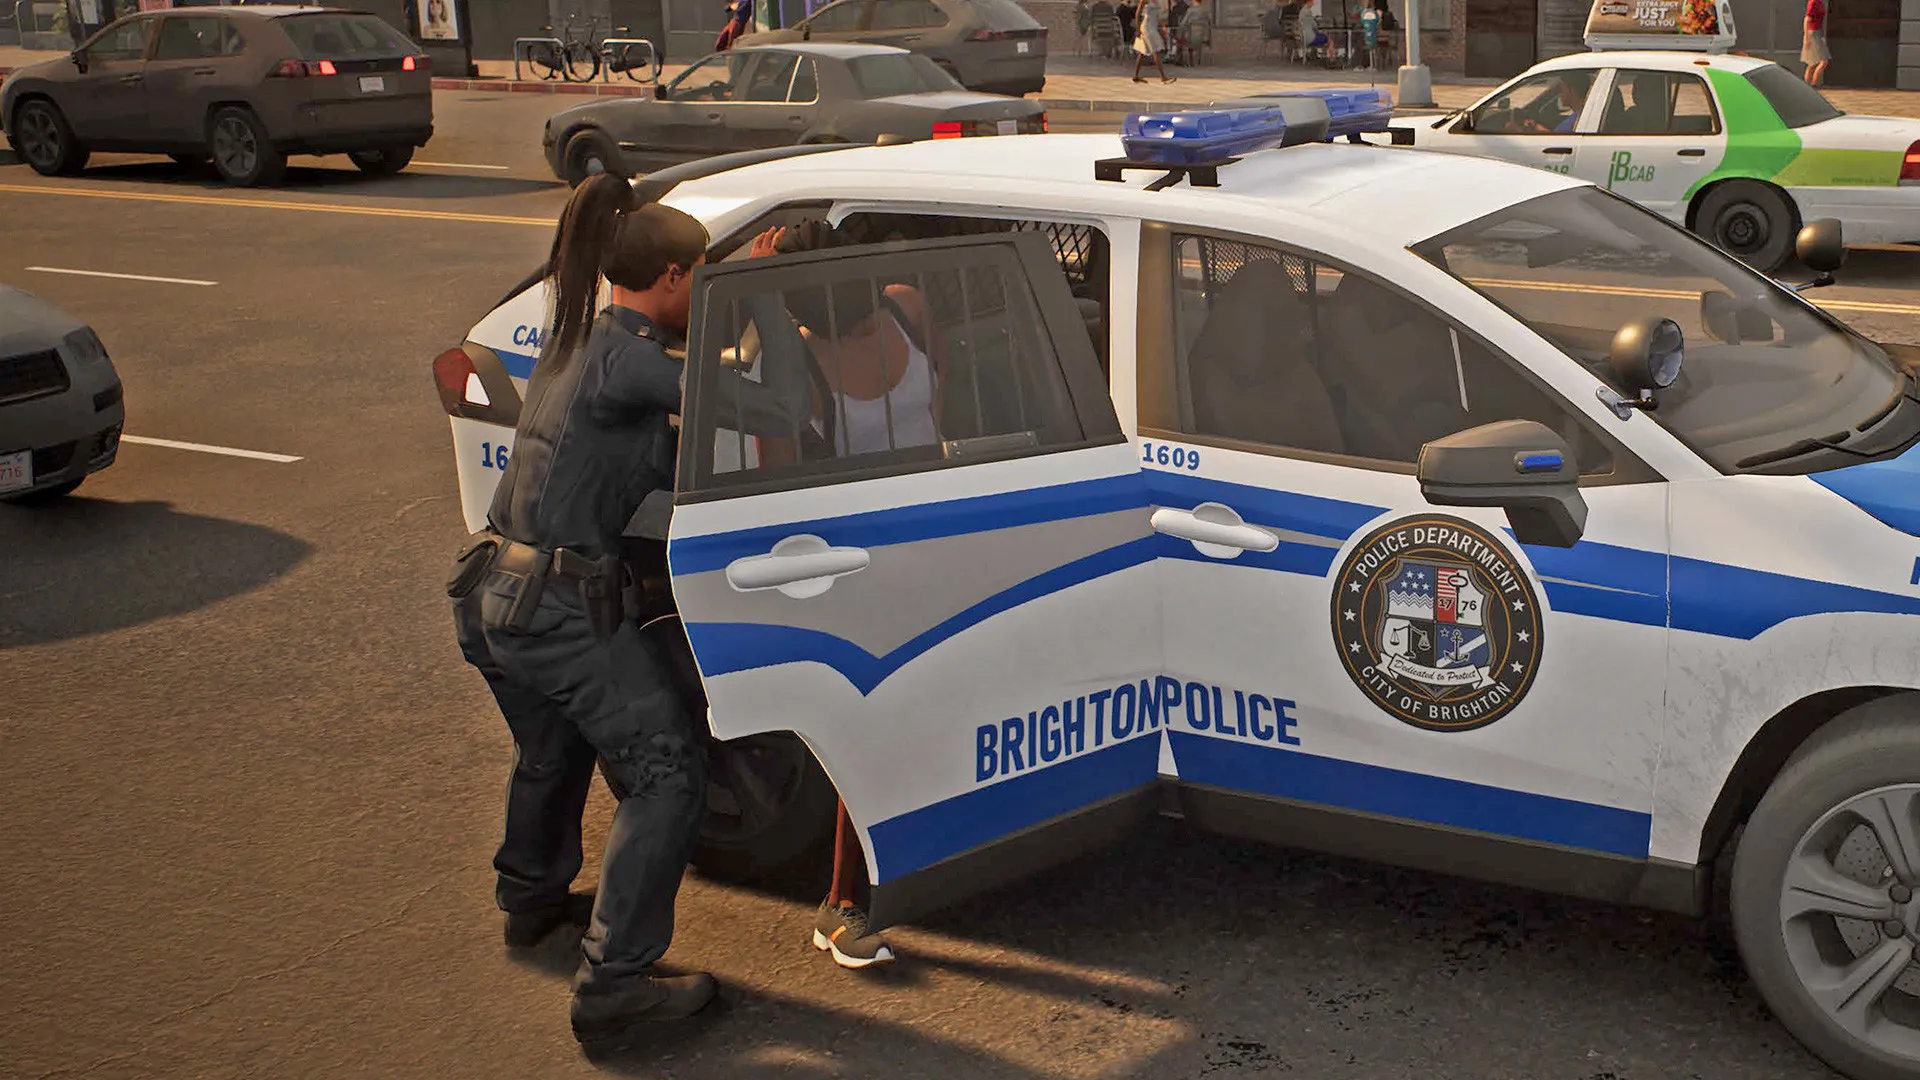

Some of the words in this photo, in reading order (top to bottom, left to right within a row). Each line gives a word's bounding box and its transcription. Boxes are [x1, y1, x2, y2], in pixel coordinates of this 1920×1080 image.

[1632, 8, 1668, 19] JUST
[1640, 19, 1656, 27] FOR
[1143, 443, 1199, 470] 1609
[1356, 530, 1410, 577] POLICE
[1414, 527, 1520, 594] DEPARTMENT
[1439, 599, 1455, 611] 17
[1462, 600, 1477, 611] 76
[1394, 659, 1434, 680] Dedicated
[1437, 673, 1445, 681] to
[1447, 670, 1476, 681] Protect
[1362, 666, 1396, 699] CITY
[1400, 696, 1423, 714] OF
[1429, 682, 1511, 720] BRIGHTON
[976, 675, 1162, 783] BRIGHTON
[1160, 675, 1300, 746] POLICE
